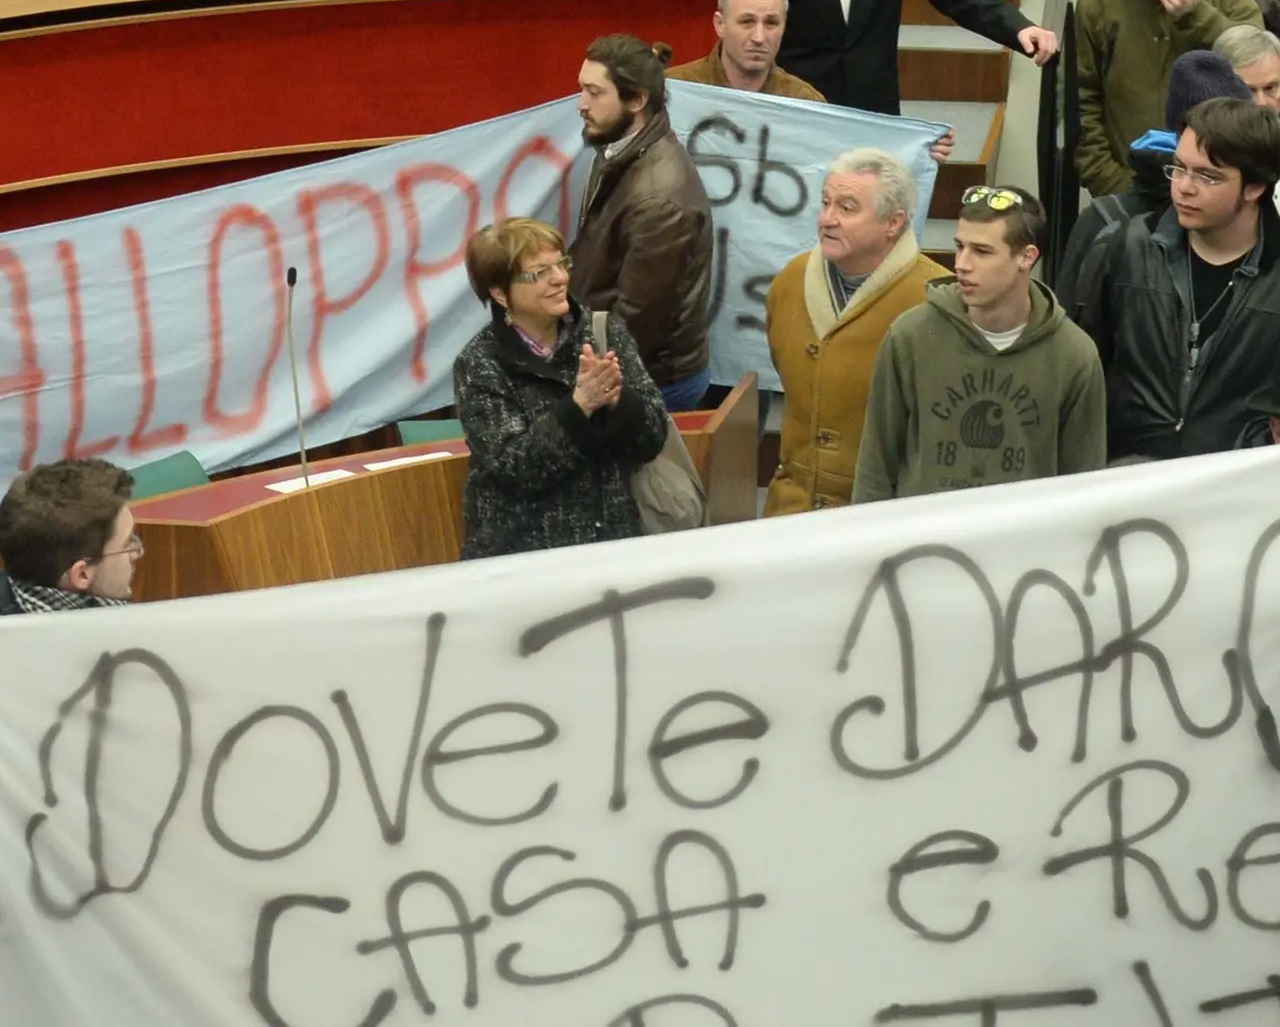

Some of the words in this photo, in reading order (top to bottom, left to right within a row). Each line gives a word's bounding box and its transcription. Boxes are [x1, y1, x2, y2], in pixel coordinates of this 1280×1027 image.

[930, 368, 1040, 427] CARHARTT
[935, 440, 958, 467] 18
[1000, 446, 1026, 473] 89
[248, 827, 766, 1027] CASA
[884, 828, 1000, 942] e
